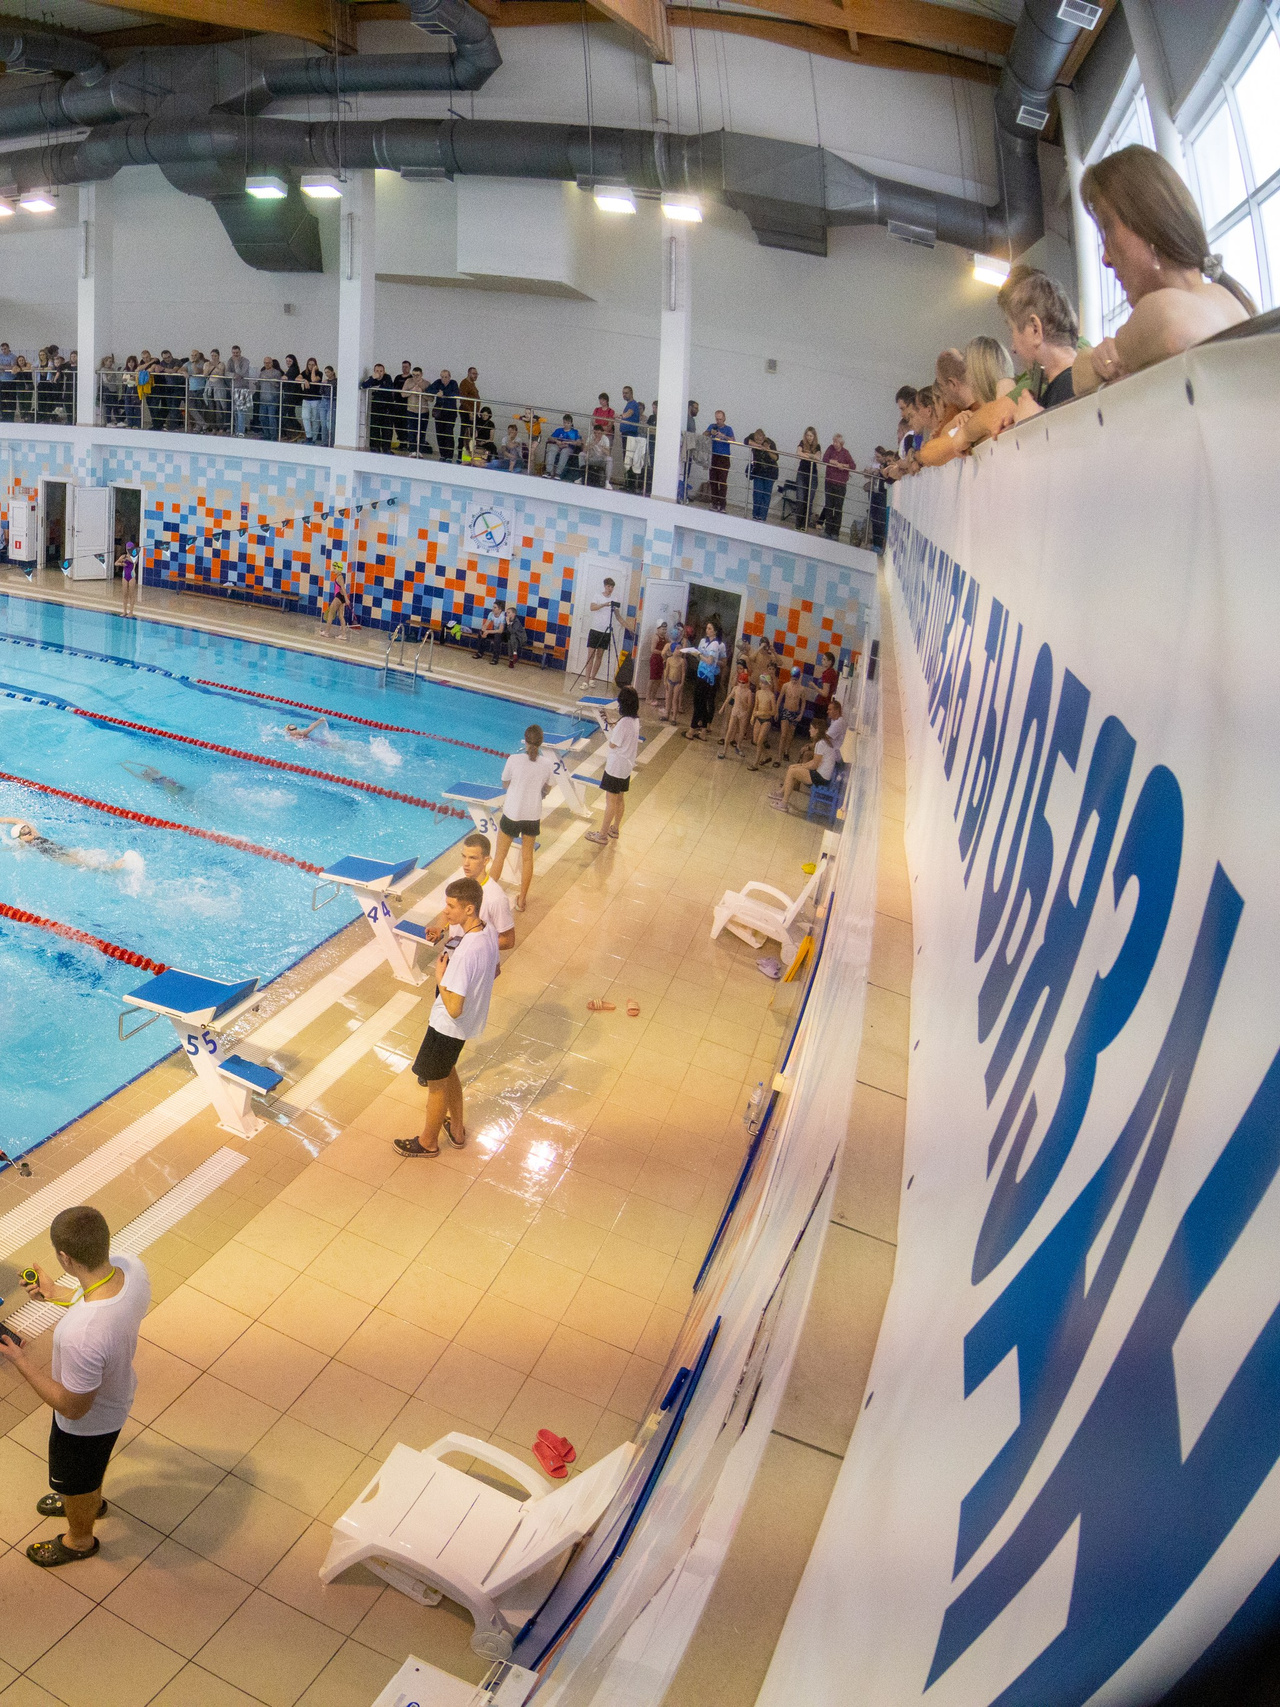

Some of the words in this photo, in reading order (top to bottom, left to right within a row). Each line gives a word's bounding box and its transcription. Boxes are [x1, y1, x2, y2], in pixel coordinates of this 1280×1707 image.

[954, 596, 1023, 890] ТЫ
[553, 762, 560, 775] 2
[479, 819, 488, 833] 3
[367, 906, 378, 923] 4
[381, 901, 391, 917] 4
[187, 1034, 199, 1056] 5
[202, 1030, 217, 1054] 5
